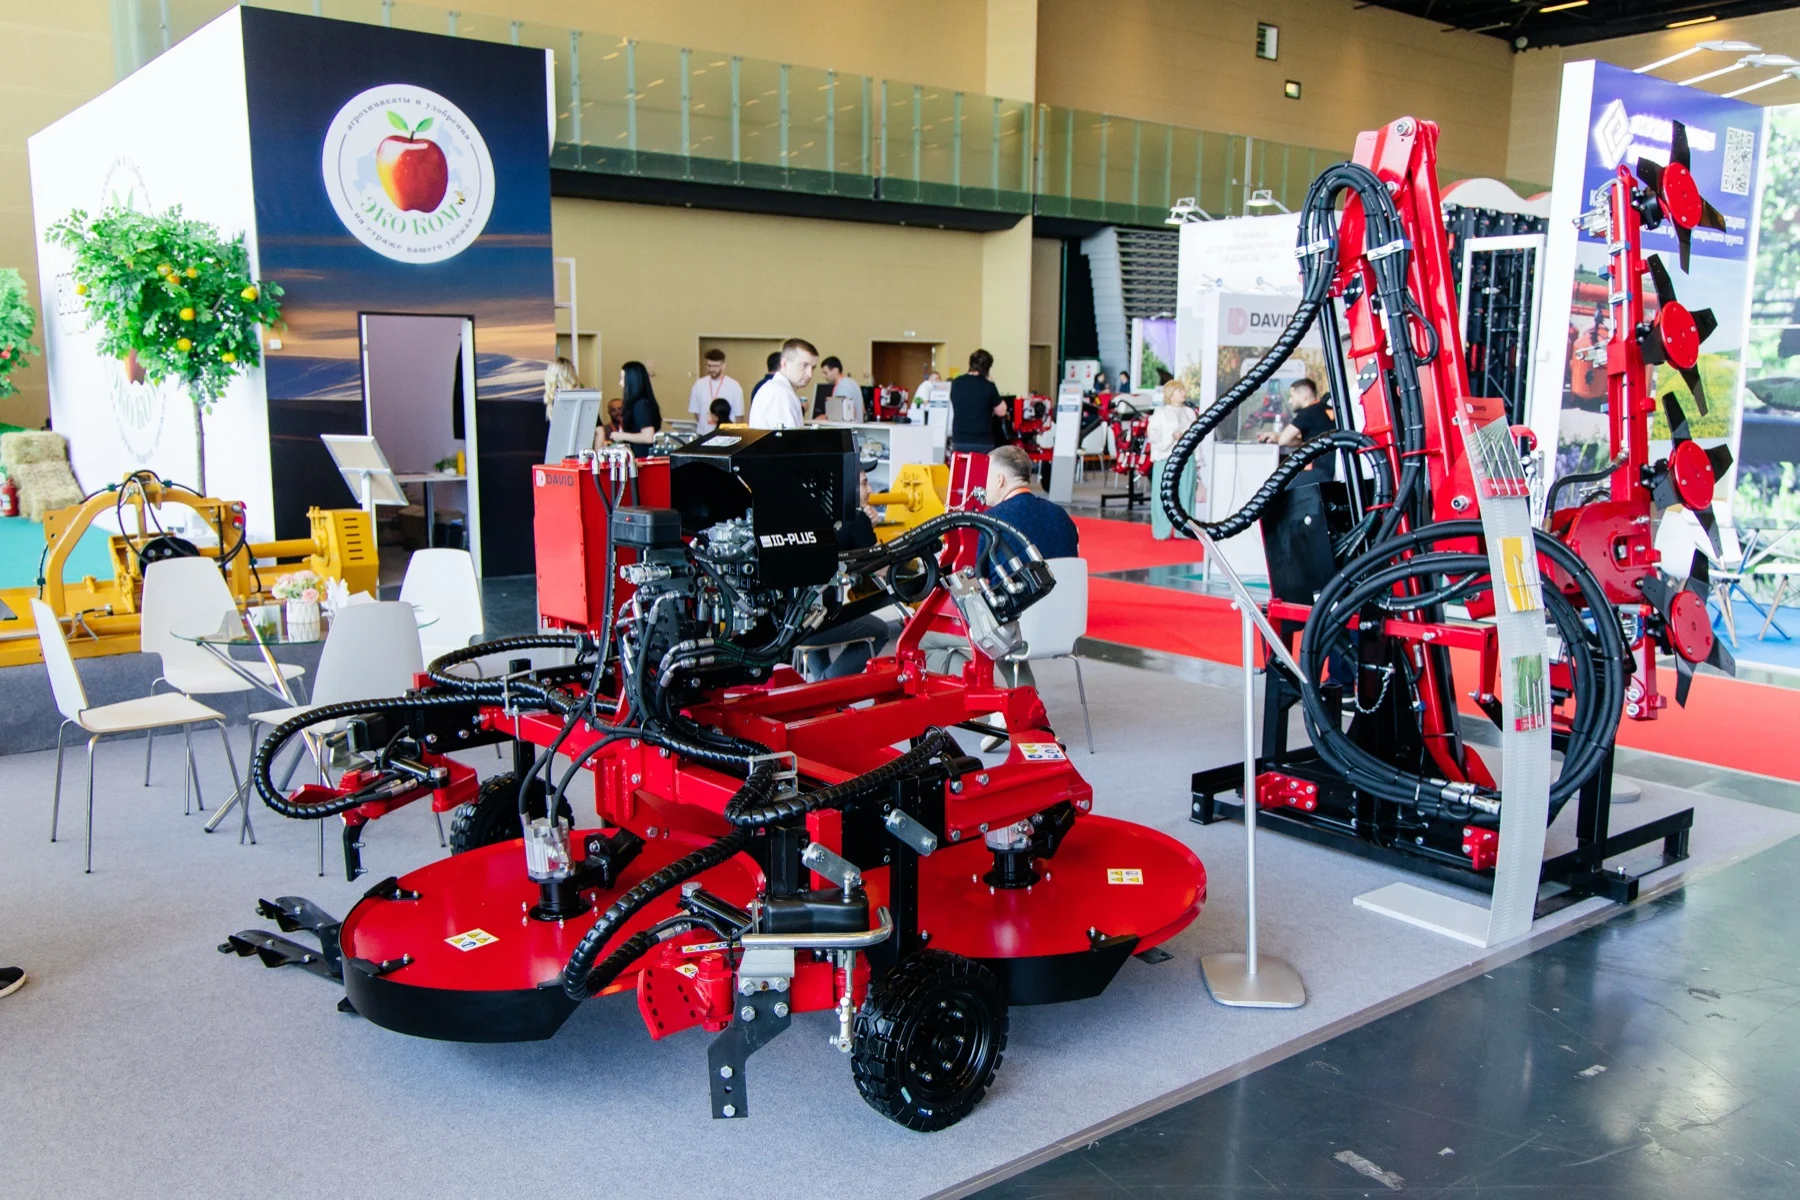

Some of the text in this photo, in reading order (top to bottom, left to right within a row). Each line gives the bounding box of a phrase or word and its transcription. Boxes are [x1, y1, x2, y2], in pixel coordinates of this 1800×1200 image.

[347, 97, 411, 131] агрохимикаты
[425, 102, 471, 141] удобрения
[354, 212, 474, 253] на страже вашего урожая
[360, 196, 461, 236] ЭКО КОМ
[545, 474, 575, 486] DAVID
[771, 531, 817, 547] ID-PLUS
